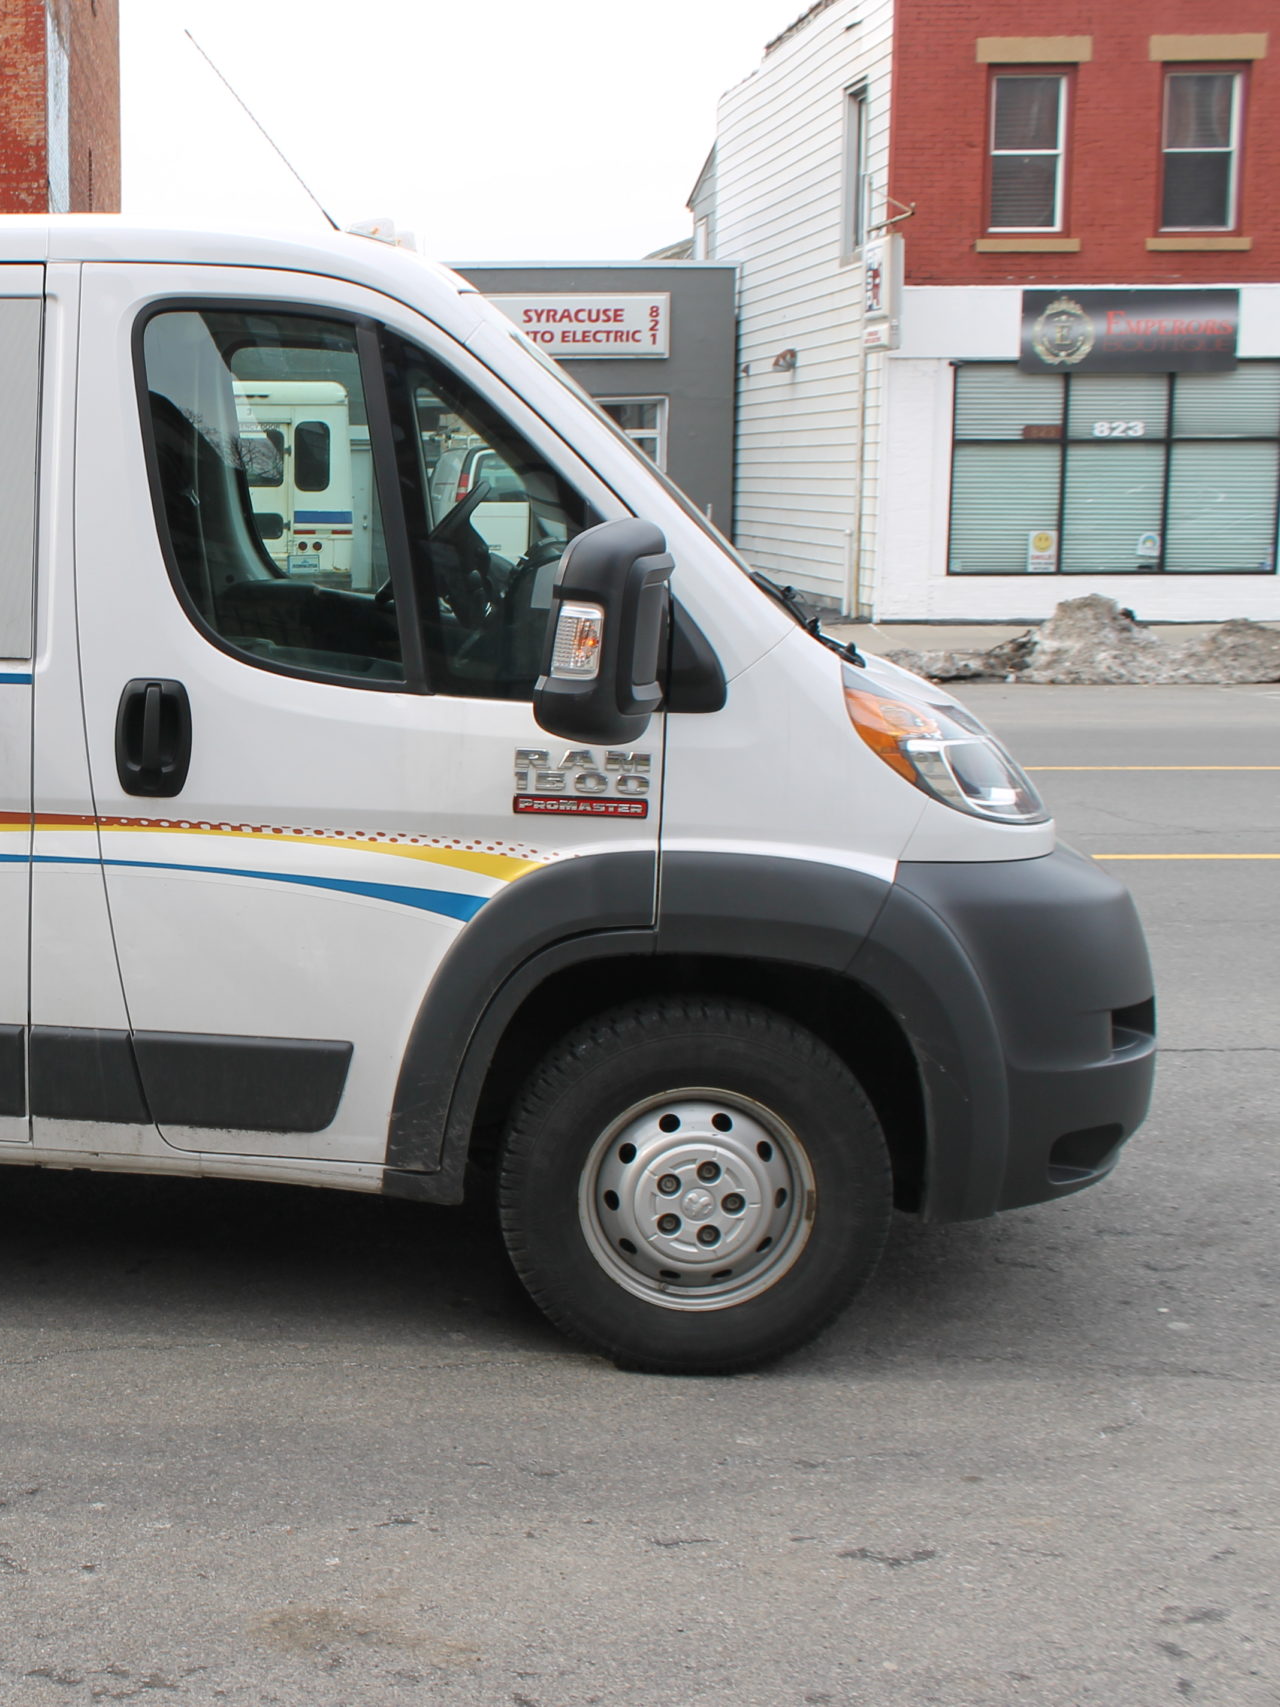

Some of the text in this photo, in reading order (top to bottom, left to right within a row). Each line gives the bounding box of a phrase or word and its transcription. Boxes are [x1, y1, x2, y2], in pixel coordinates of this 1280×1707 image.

[523, 308, 624, 324] SYRACUSE
[1104, 309, 1234, 336] EMPERORS
[524, 329, 642, 344] TO ELECTRIC
[1093, 421, 1145, 438] 823
[515, 748, 652, 773] RAM
[515, 771, 650, 795] 1500
